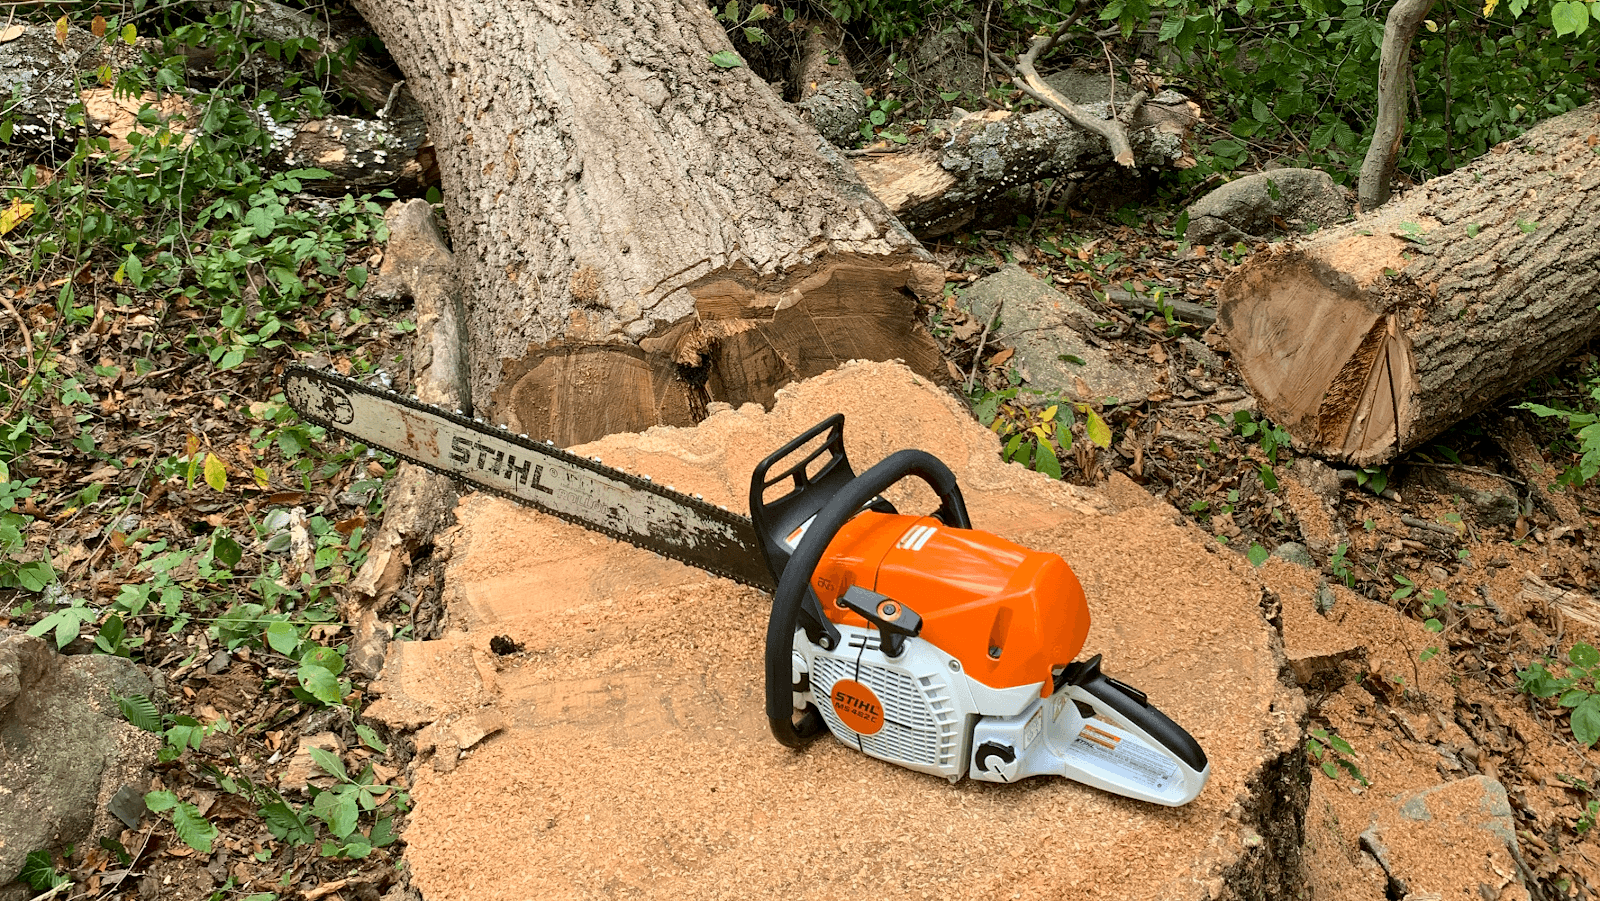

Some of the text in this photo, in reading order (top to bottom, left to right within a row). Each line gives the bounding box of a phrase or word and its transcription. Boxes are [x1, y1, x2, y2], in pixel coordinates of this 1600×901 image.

[448, 435, 553, 495] STIHL
[835, 691, 879, 716] STIHL
[835, 702, 850, 713] MS
